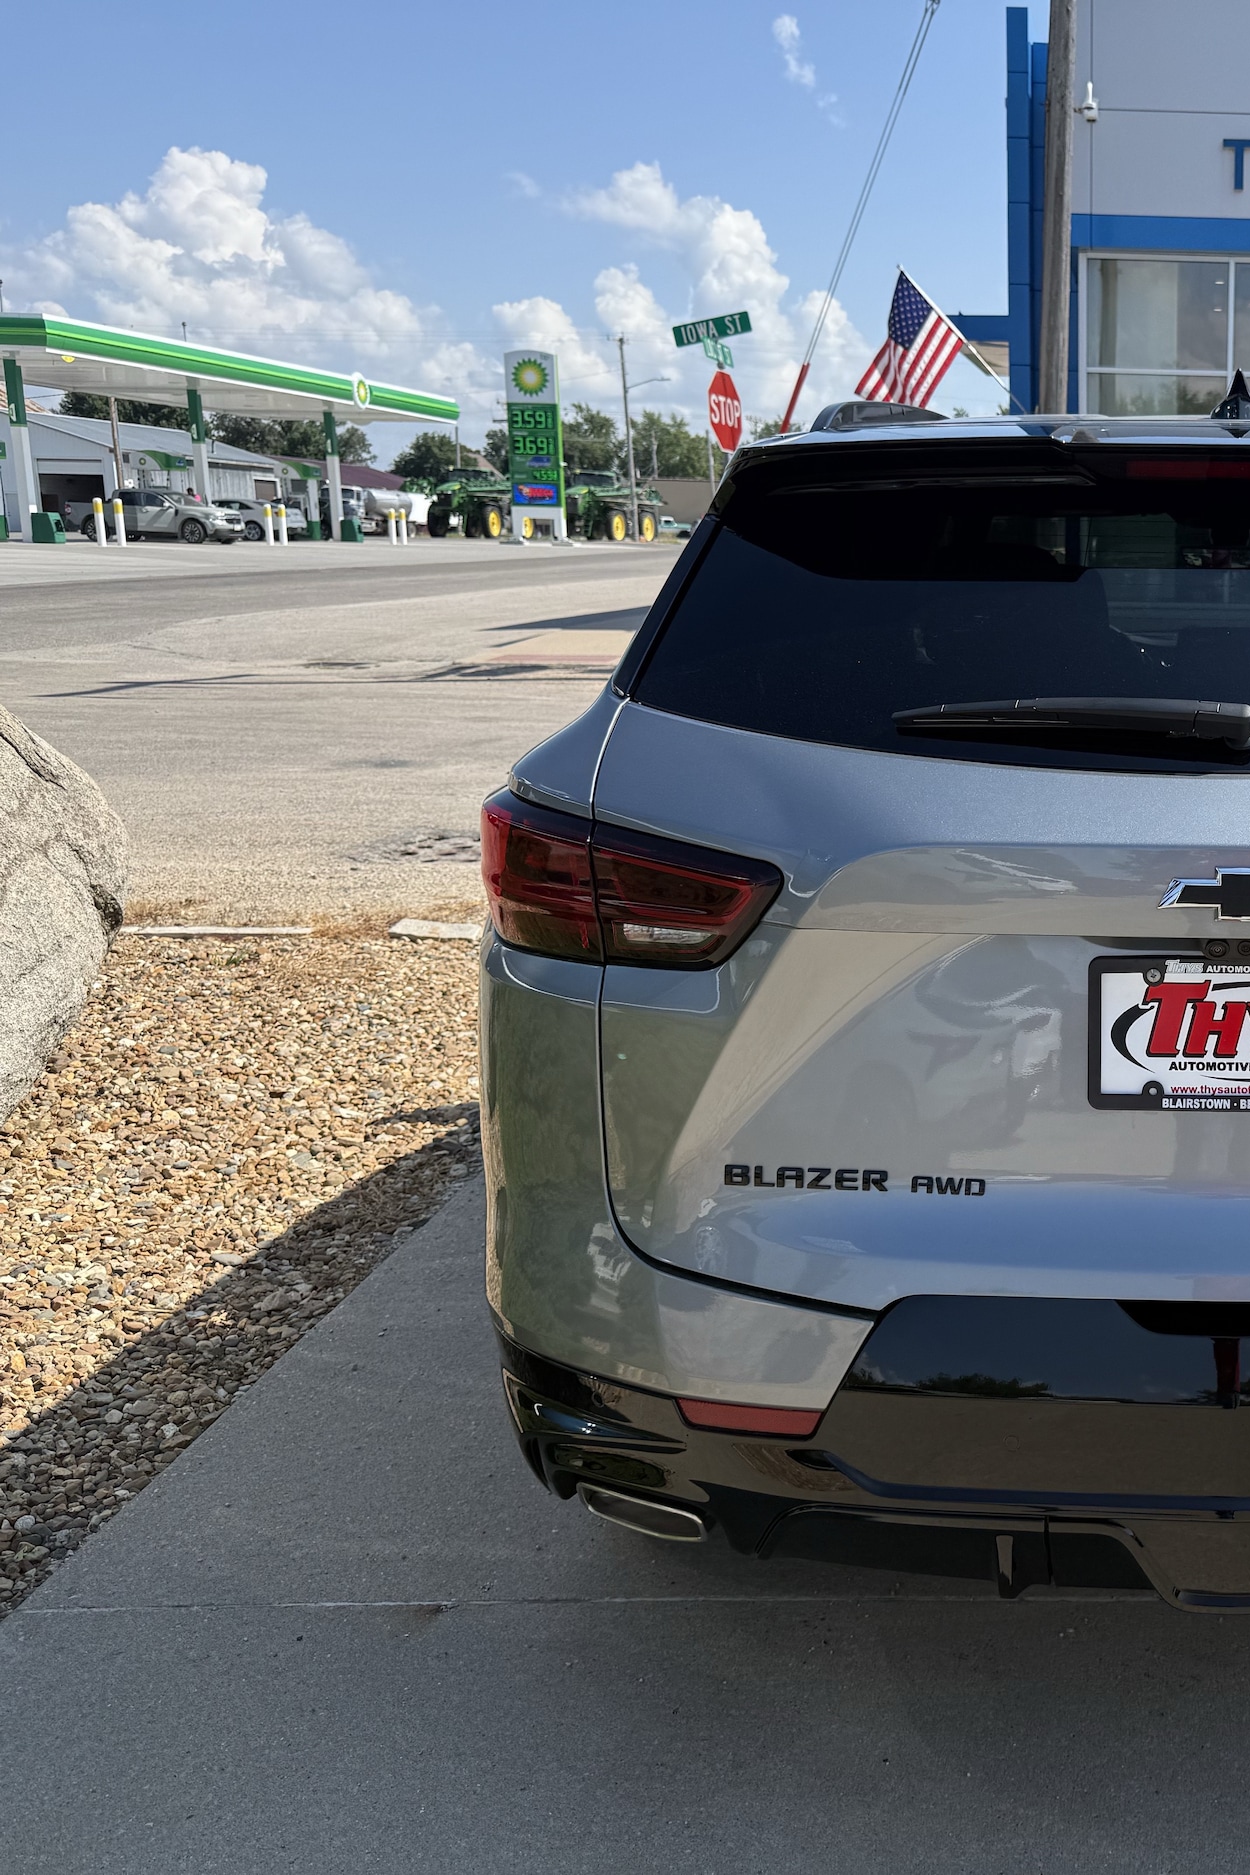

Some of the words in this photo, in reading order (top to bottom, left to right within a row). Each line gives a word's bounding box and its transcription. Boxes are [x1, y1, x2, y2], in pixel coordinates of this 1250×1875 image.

[680, 320, 719, 344] IOWA
[724, 314, 742, 335] ST
[710, 393, 741, 429] STOP
[1162, 1097, 1231, 1110] BLAIRSTOWN
[724, 1164, 889, 1192] BLAZER
[911, 1175, 986, 1197] AWD
